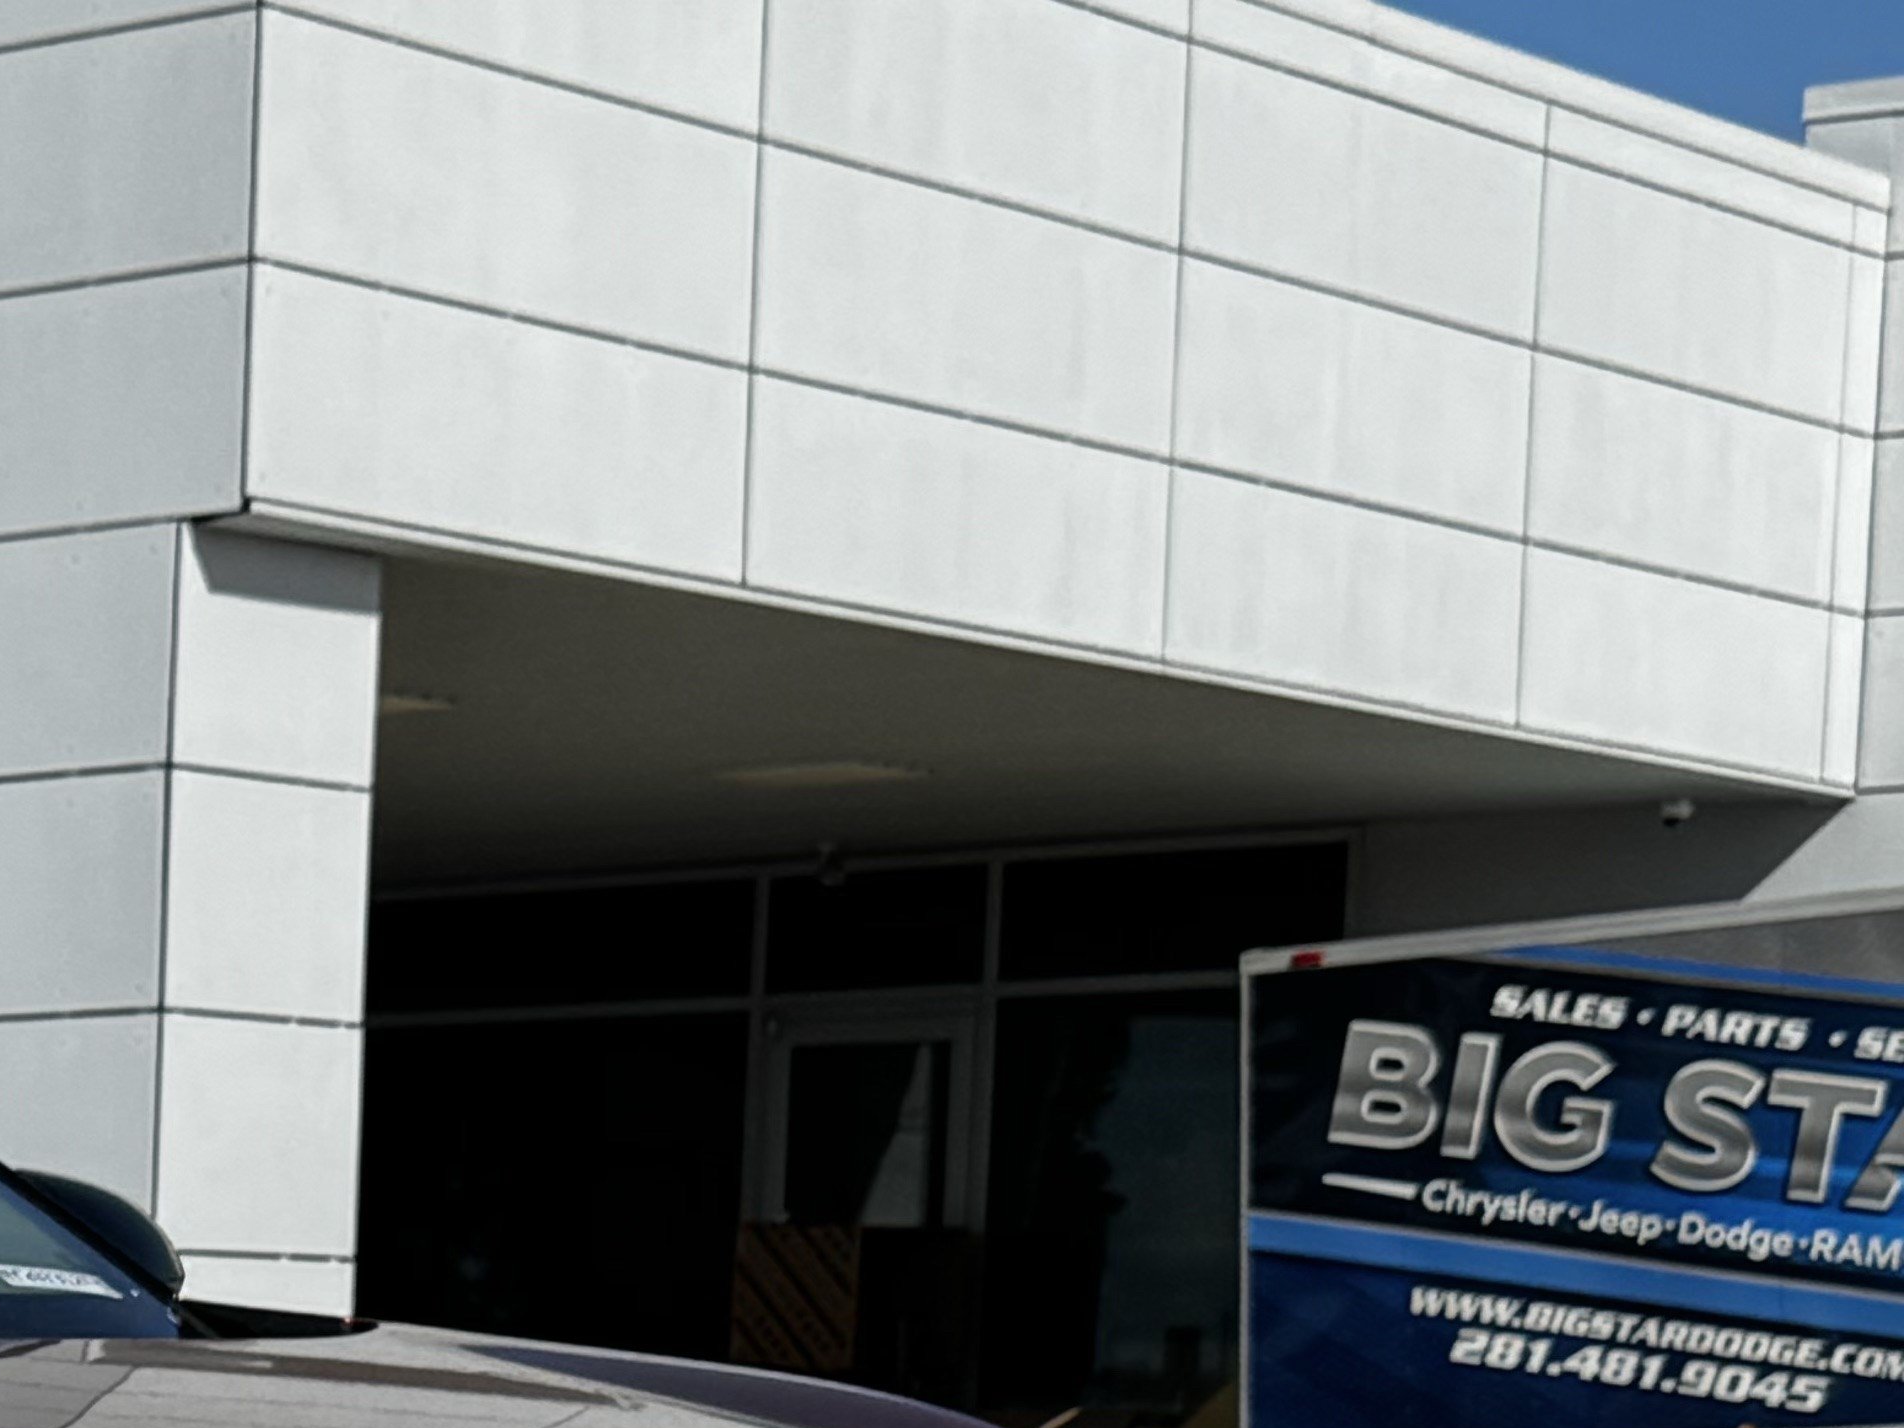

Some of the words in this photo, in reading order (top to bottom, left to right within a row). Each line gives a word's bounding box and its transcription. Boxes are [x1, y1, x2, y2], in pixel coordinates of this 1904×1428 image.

[1490, 984, 1630, 1030] SALES
[1662, 1004, 1812, 1051] PARTS
[1328, 1019, 1616, 1172] BIG
[1421, 1178, 1570, 1226] Chrysler
[1578, 1205, 1663, 1246] Jeep
[1677, 1211, 1792, 1263] Dodge
[1809, 1228, 1904, 1272] RAM
[1448, 1328, 1832, 1414] 281.481.9045
